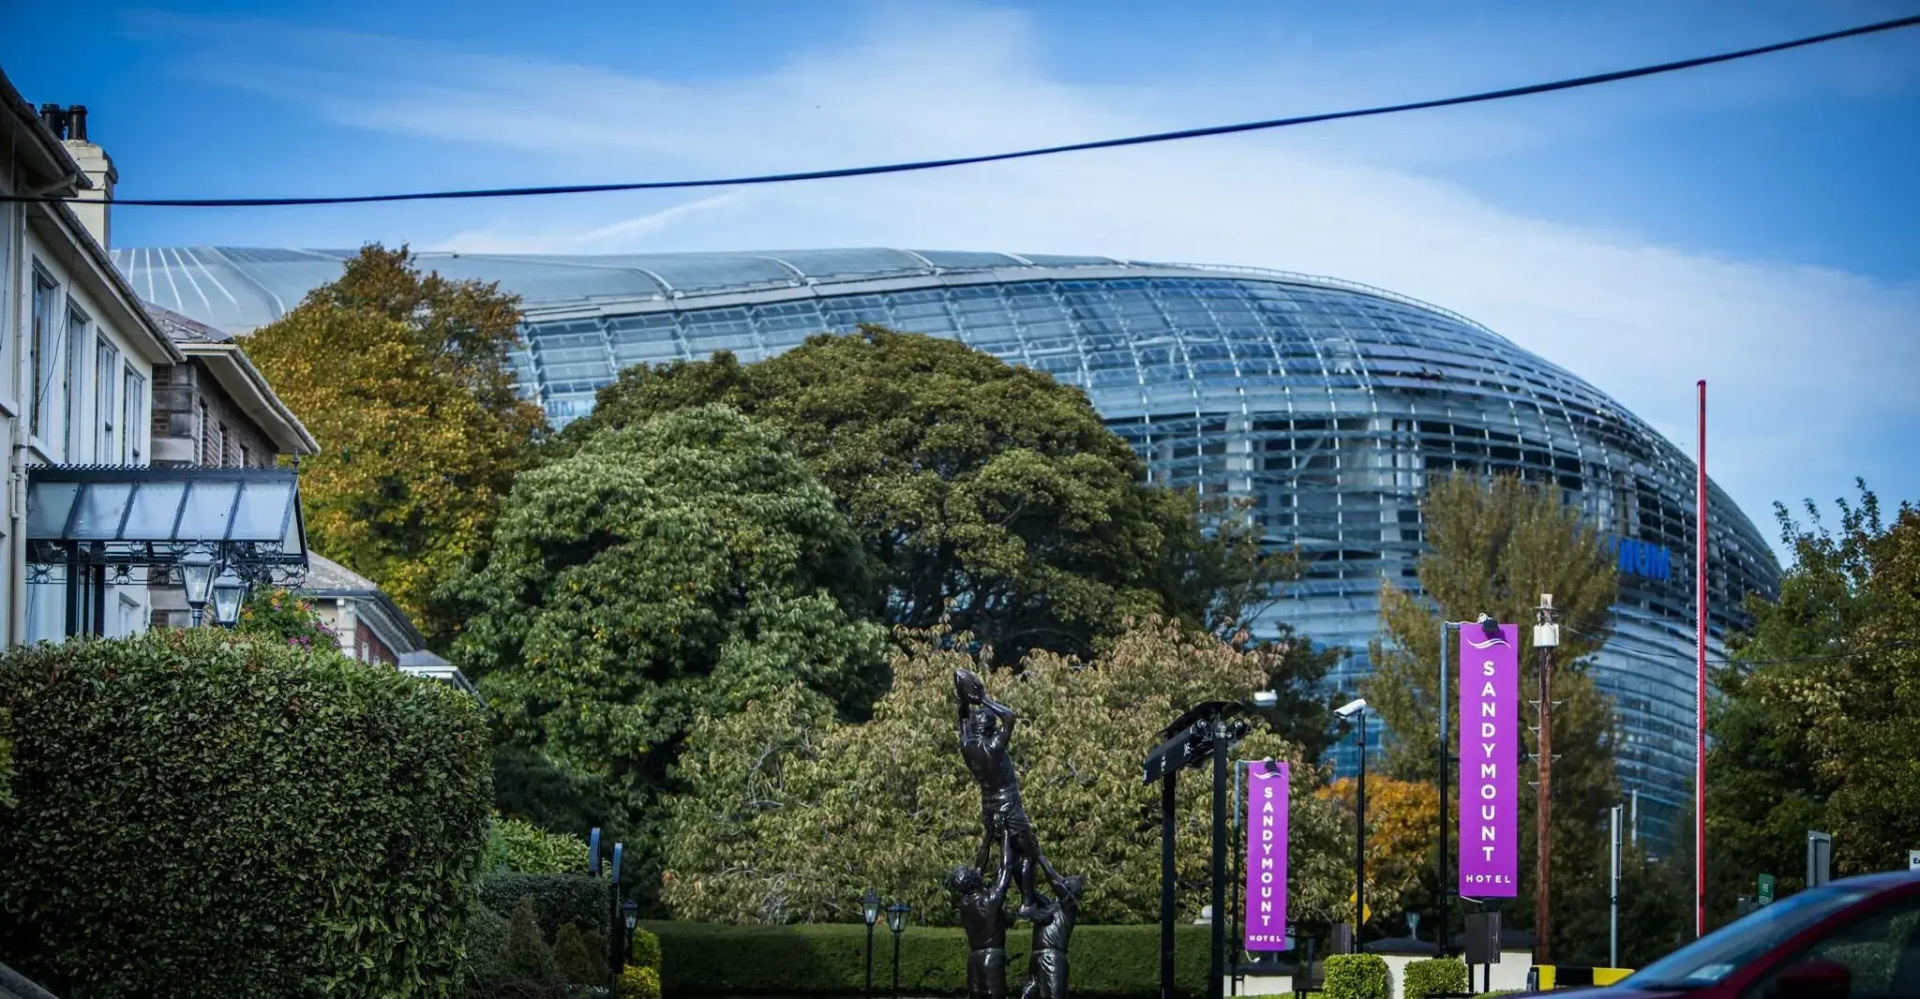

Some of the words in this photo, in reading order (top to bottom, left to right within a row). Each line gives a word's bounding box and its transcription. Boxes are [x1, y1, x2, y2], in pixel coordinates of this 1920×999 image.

[1480, 660, 1497, 862] SANDYMOUNT
[1260, 786, 1275, 926] SANDYMOUNT
[1466, 874, 1511, 884] HOTEL
[1249, 934, 1282, 943] HOTEL
